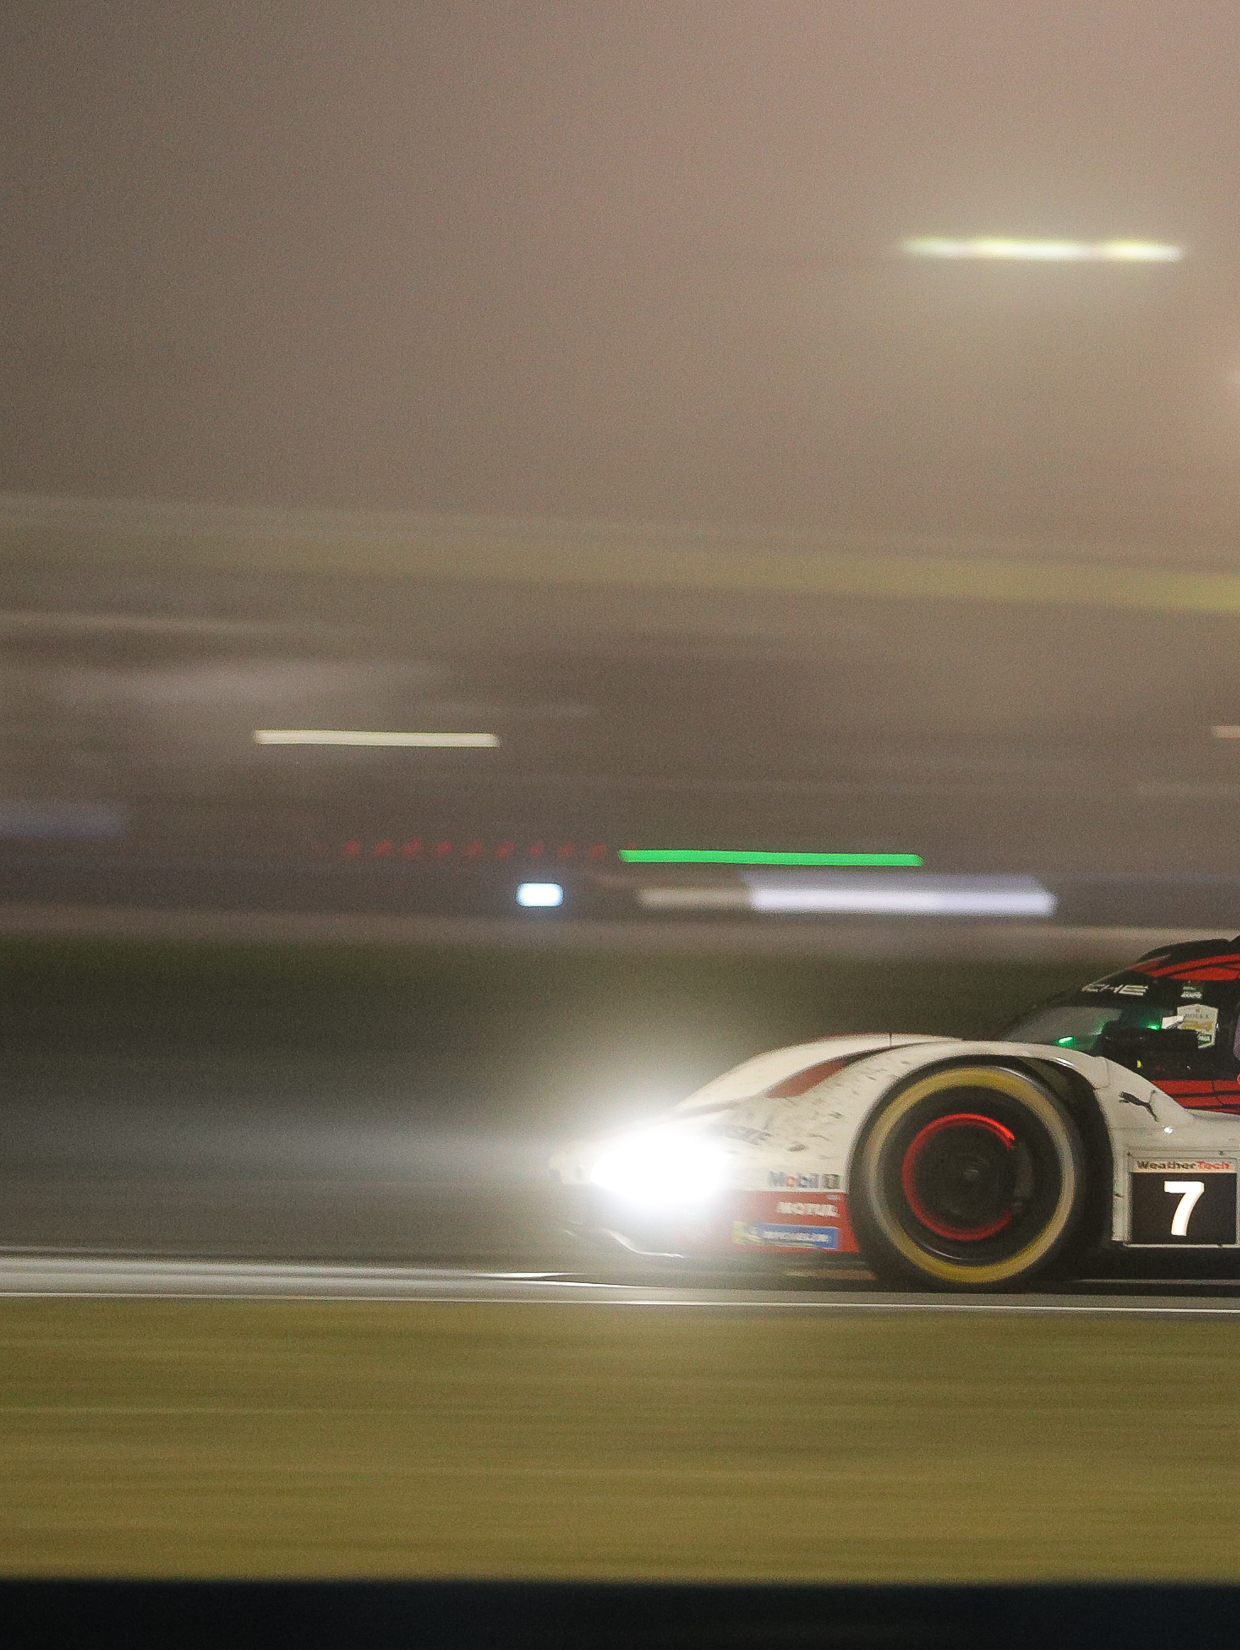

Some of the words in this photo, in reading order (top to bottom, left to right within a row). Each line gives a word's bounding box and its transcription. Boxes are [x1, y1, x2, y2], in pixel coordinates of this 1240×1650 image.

[1136, 1161, 1231, 1171] WeatherTech
[769, 1170, 819, 1188] Mobil
[1163, 1180, 1205, 1237] 7
